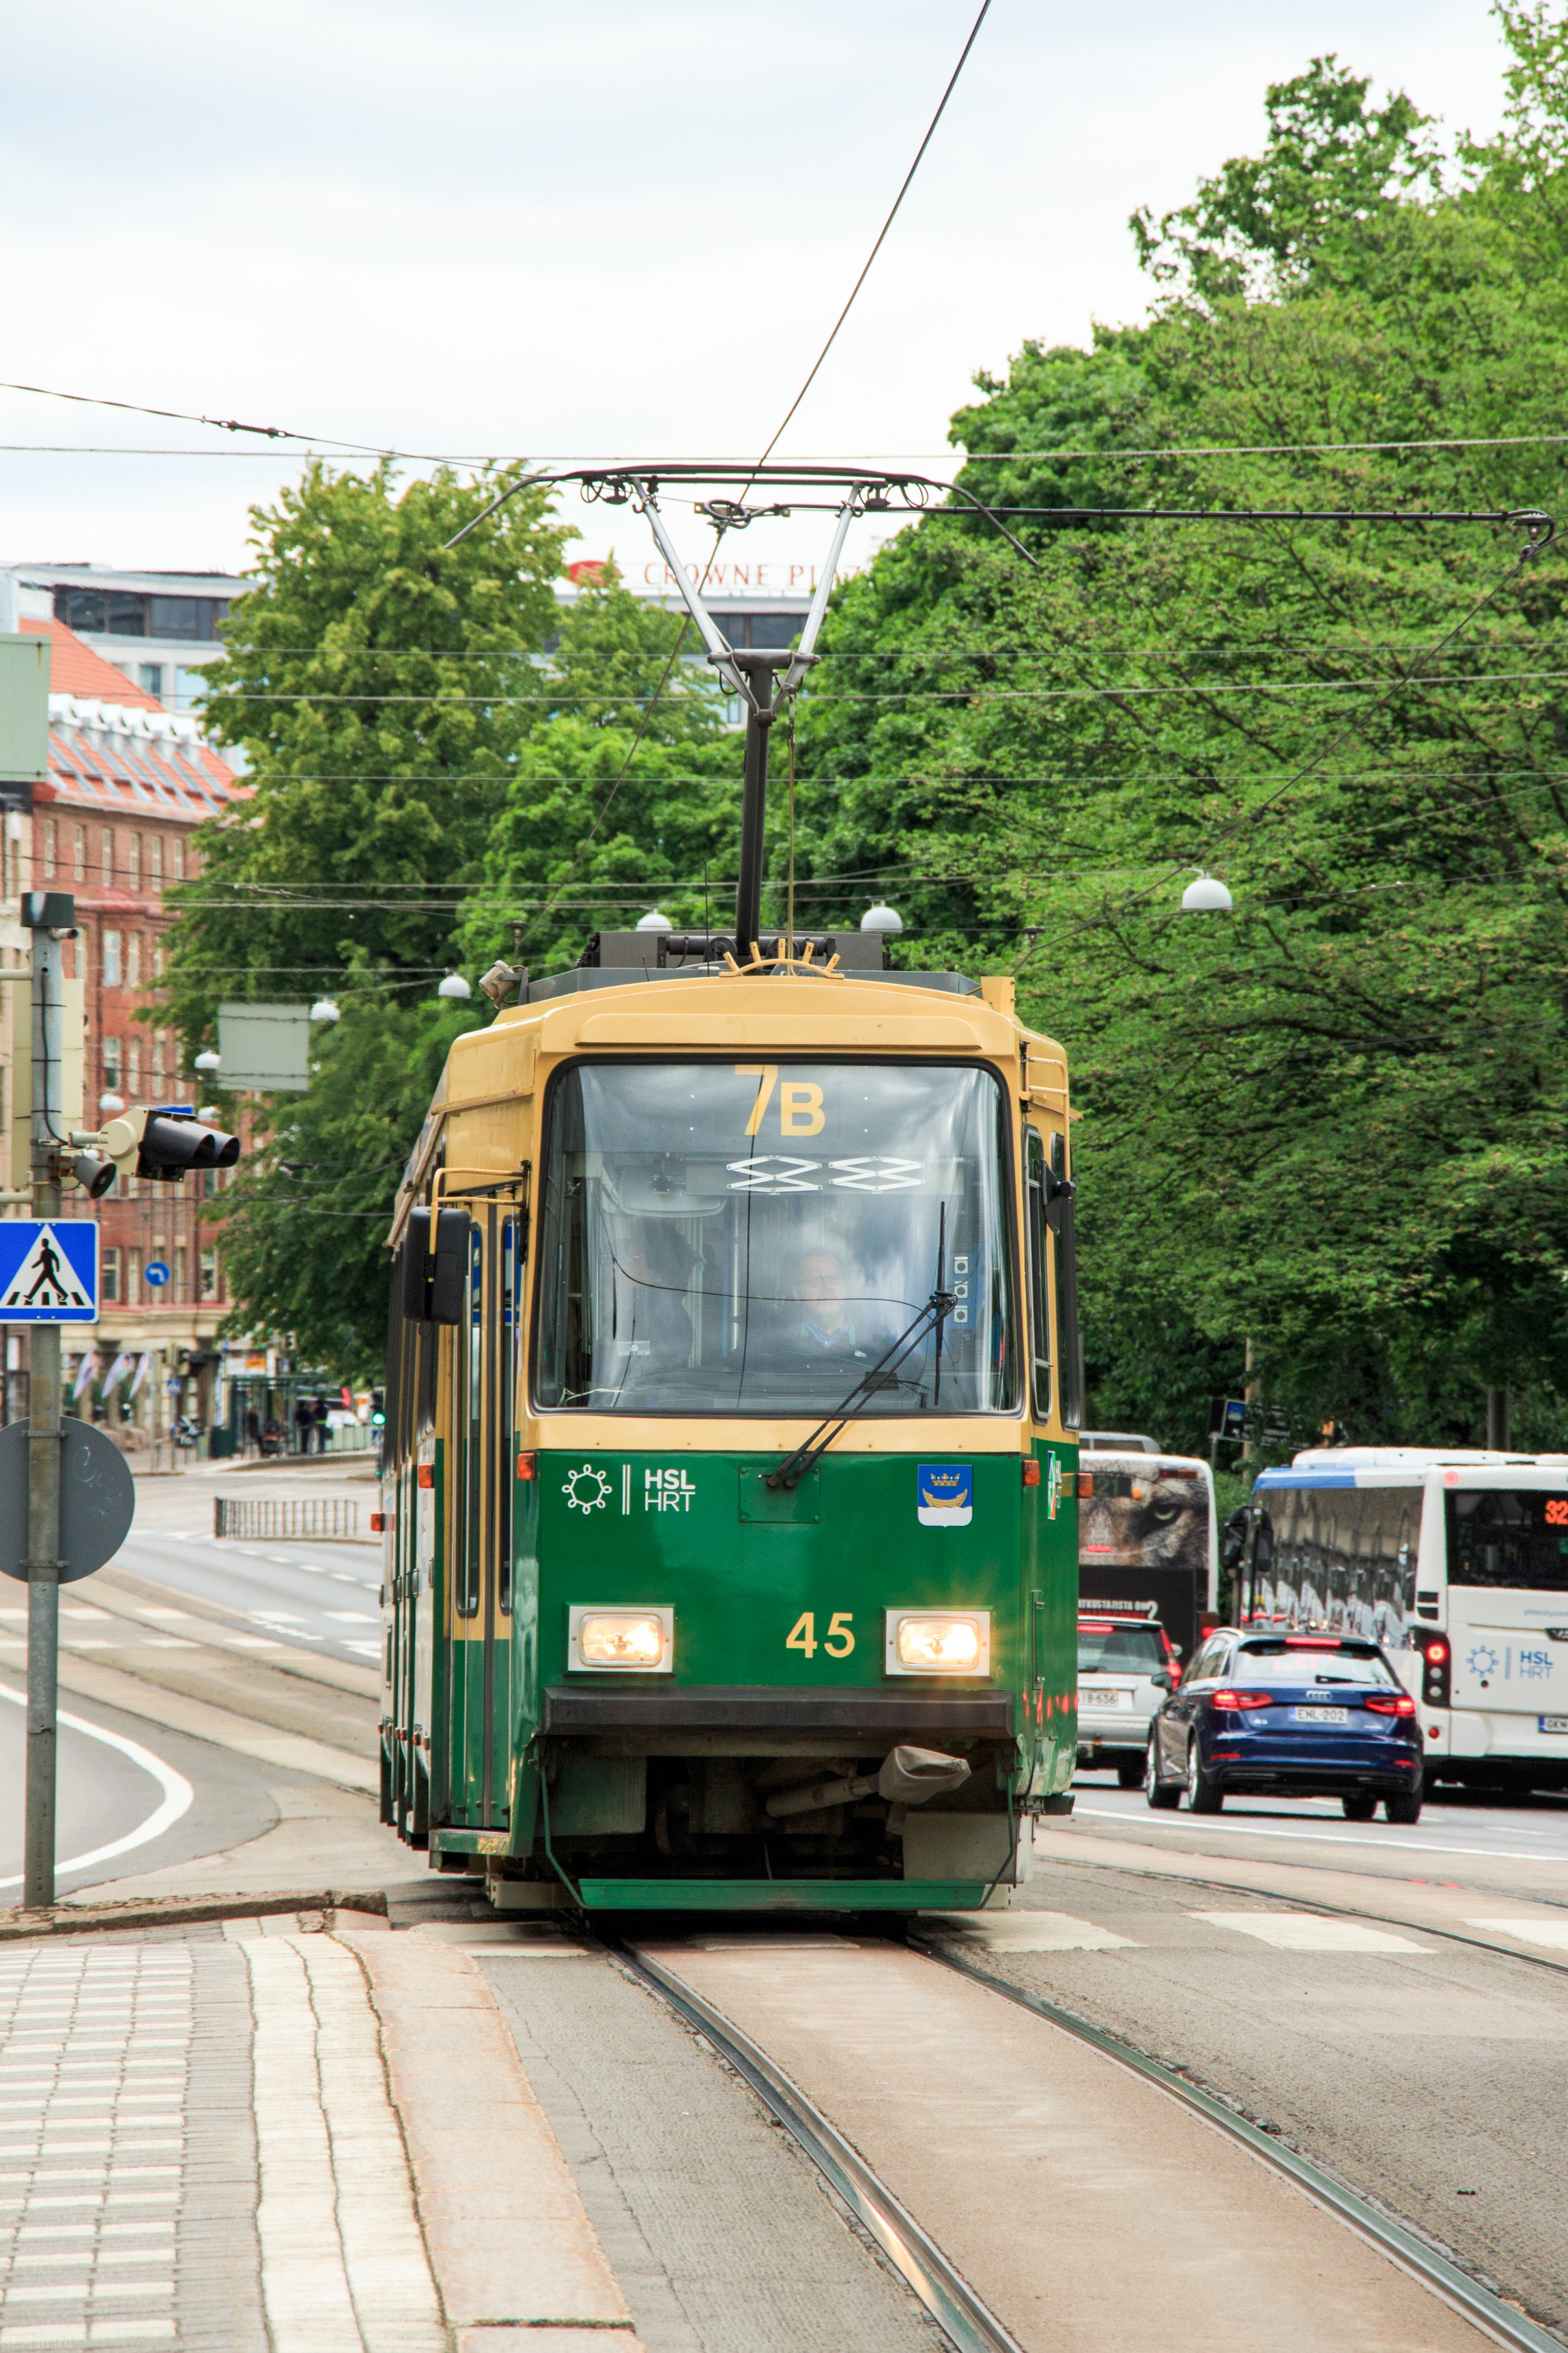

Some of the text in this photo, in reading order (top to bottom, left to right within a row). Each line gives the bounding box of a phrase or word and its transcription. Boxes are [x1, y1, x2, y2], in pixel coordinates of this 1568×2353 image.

[644, 563, 770, 585] CROWNE
[735, 1065, 826, 1136] 7B
[645, 1469, 696, 1490] HSL
[645, 1491, 696, 1512] HRT
[786, 1611, 856, 1659] 45
[1520, 1651, 1553, 1665] HSL
[1519, 1665, 1553, 1680] HRT
[1297, 1709, 1345, 1722] ENL-202
